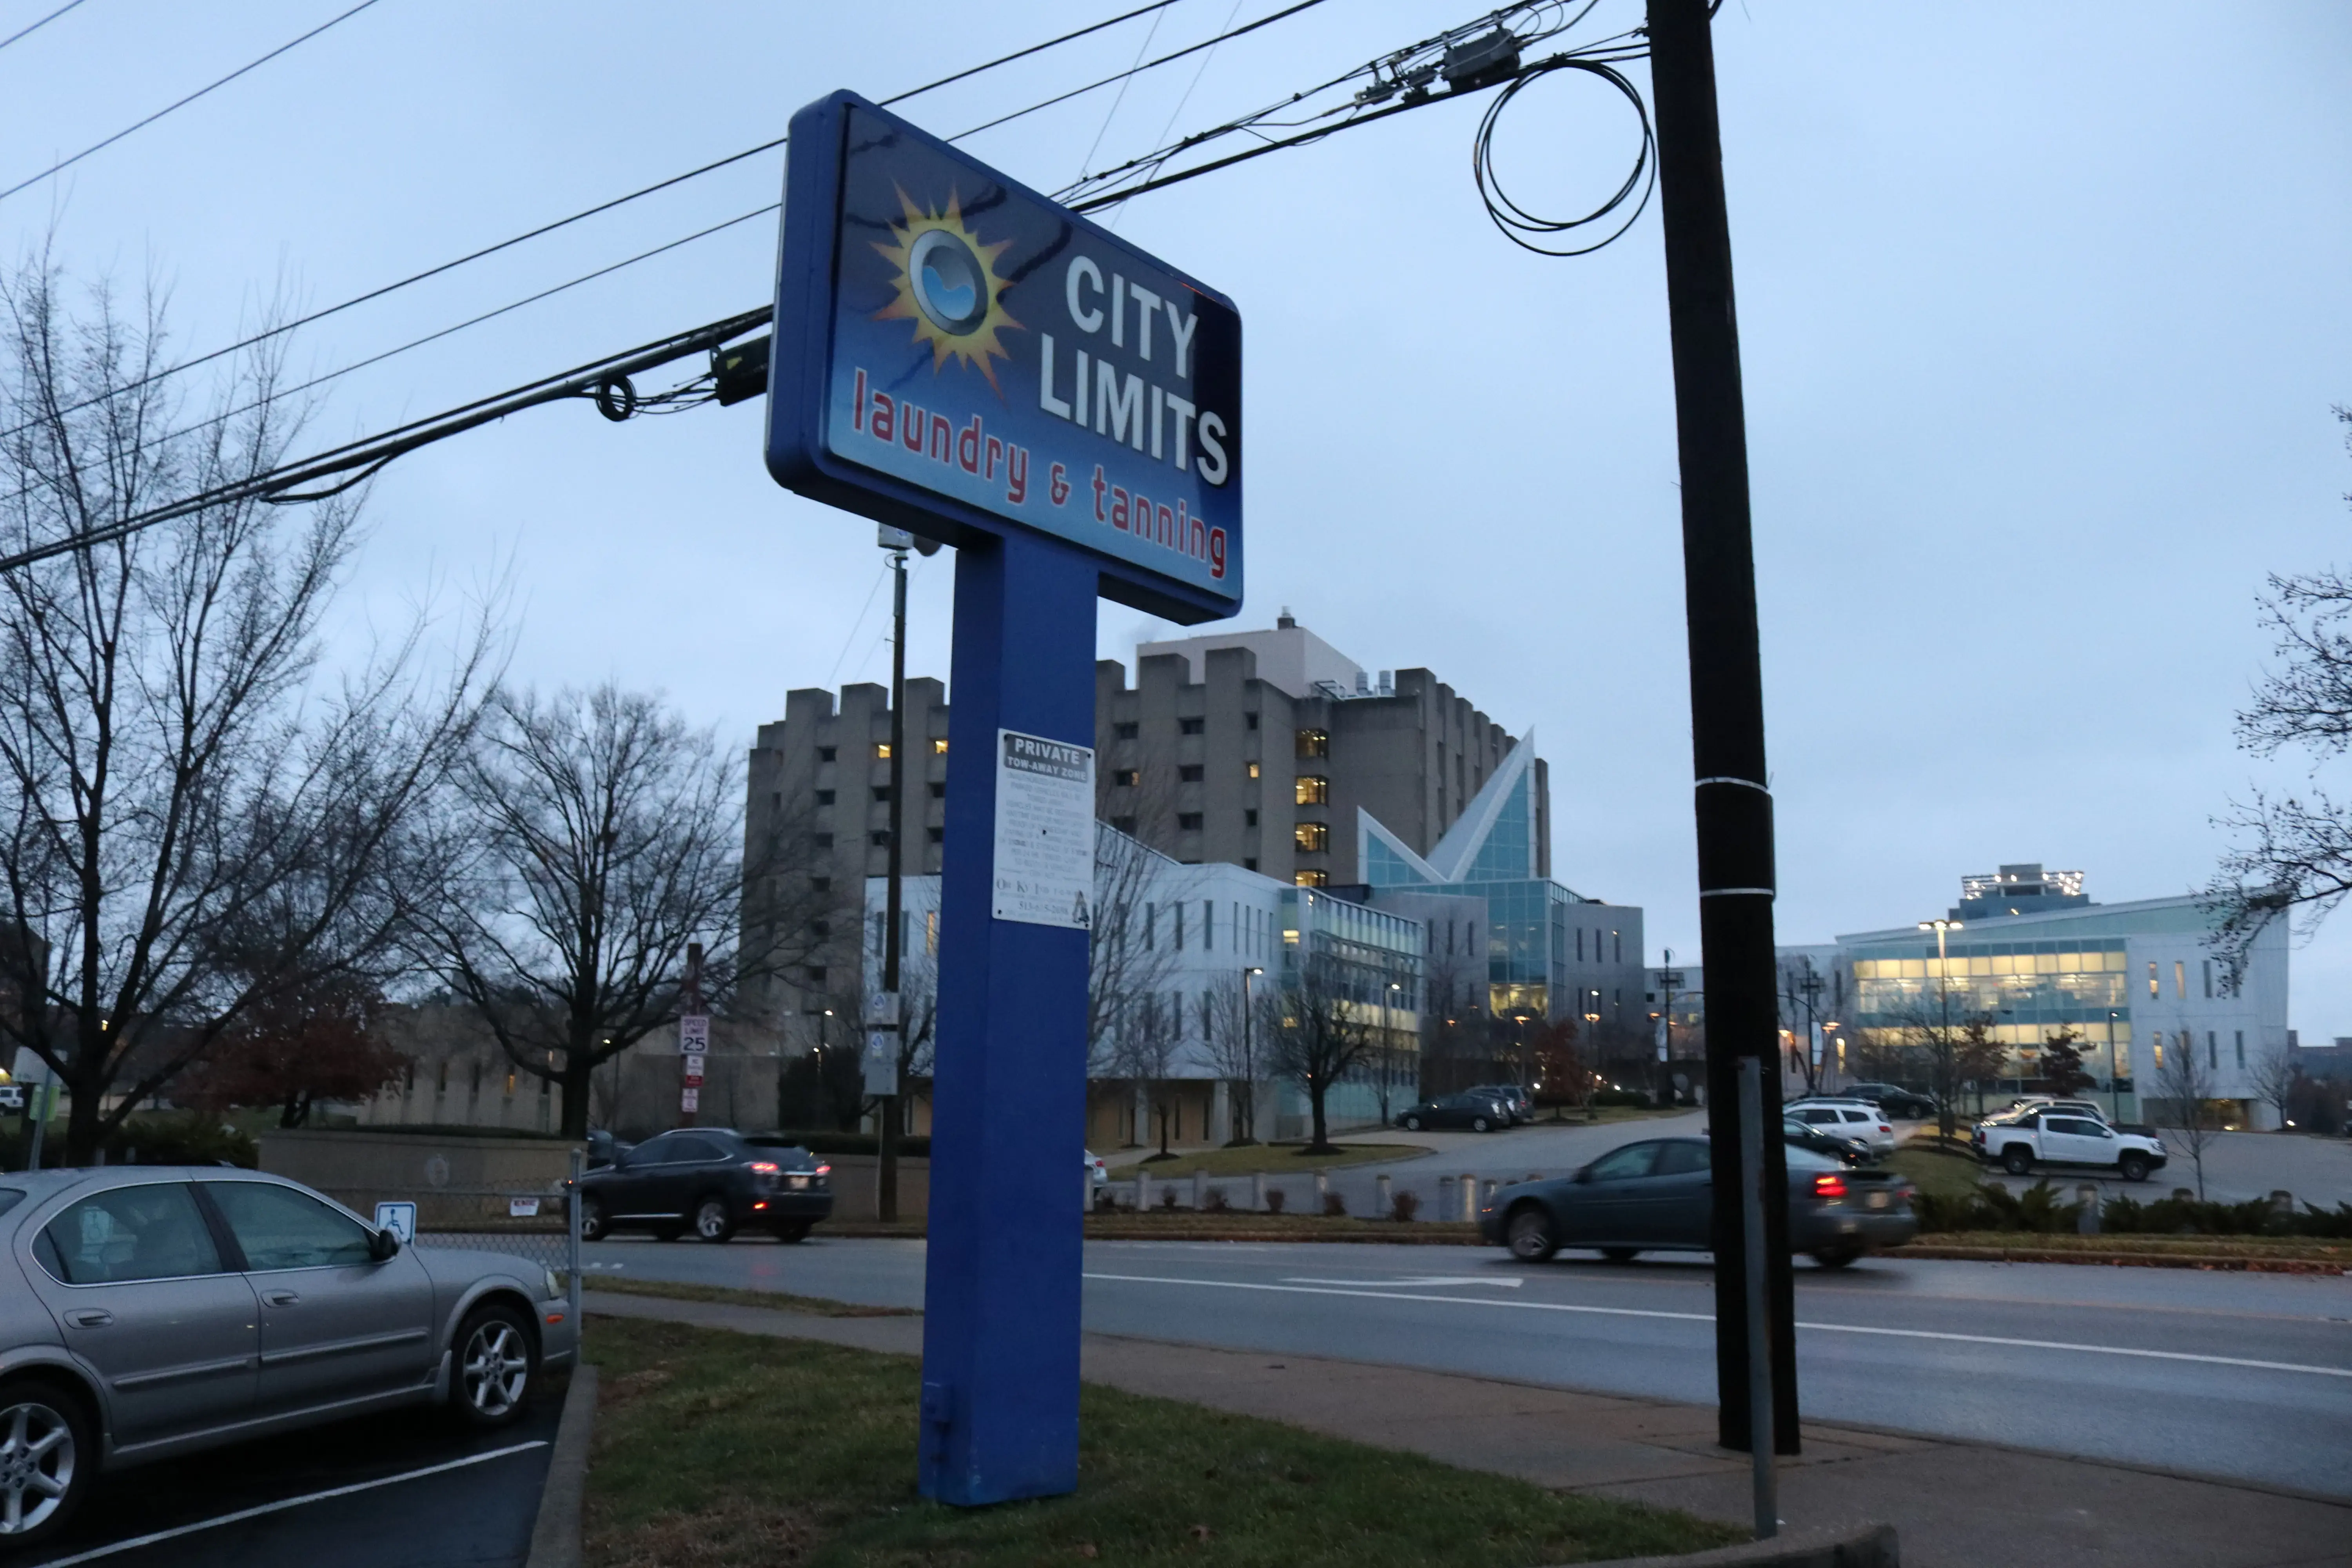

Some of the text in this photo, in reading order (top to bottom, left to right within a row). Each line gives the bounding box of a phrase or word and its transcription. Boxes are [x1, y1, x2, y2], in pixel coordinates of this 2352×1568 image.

[1066, 256, 1198, 379] CITY
[1040, 334, 1228, 485] LIMITS
[854, 368, 1227, 578] laundry & tanning
[1007, 756, 1087, 780] TOW-AWAY ZONE
[1015, 738, 1080, 764] PRIVATE
[684, 1037, 705, 1051] 25
